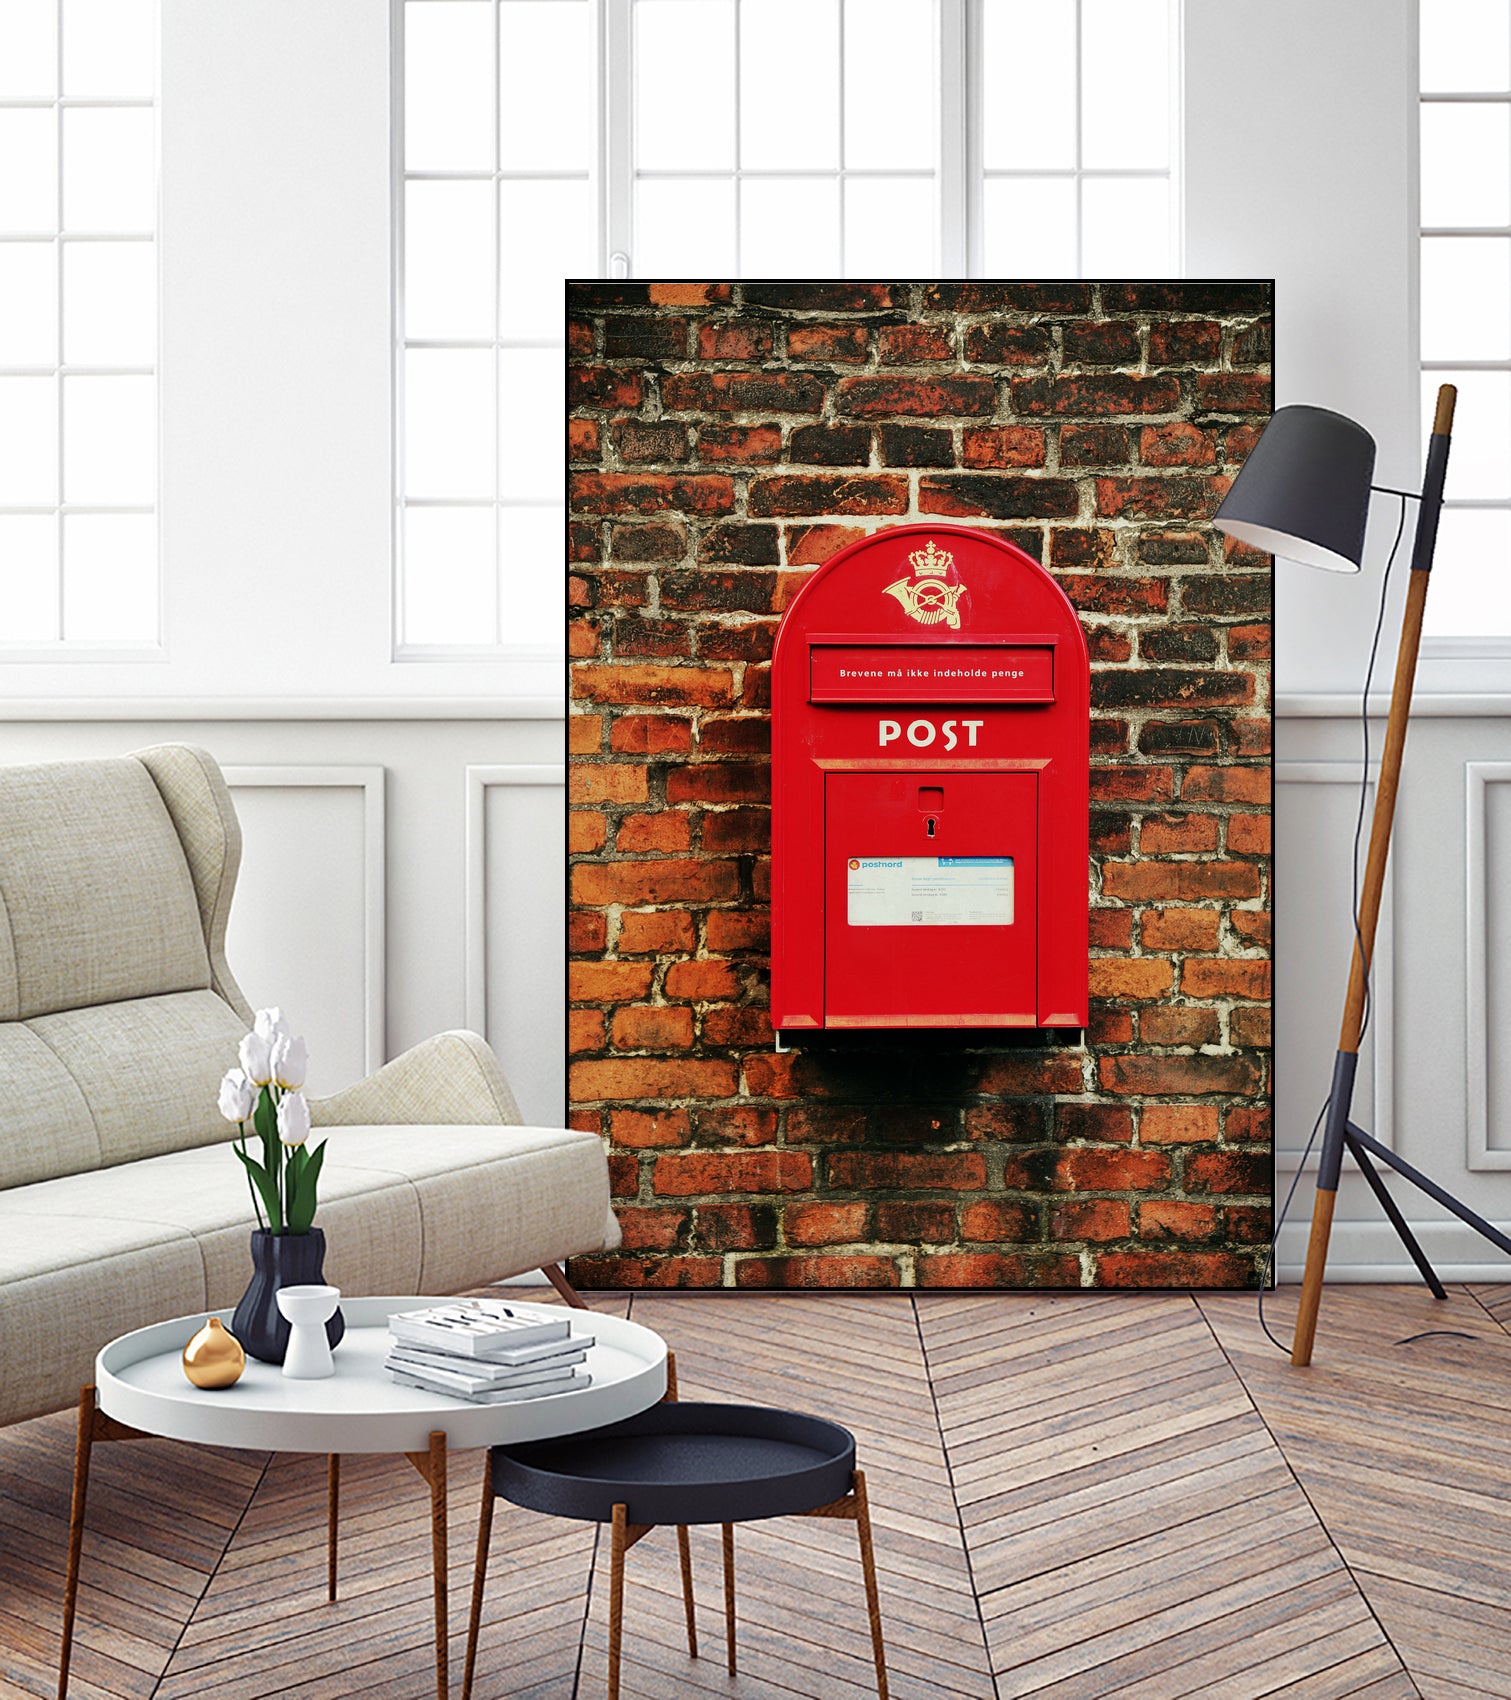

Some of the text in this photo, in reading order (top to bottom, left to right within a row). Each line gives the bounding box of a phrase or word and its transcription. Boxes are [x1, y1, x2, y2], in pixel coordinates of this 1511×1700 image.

[840, 668, 1024, 679] Brevene må ikke indeholde penge
[879, 719, 984, 752] POST
[862, 861, 903, 869] postnord
